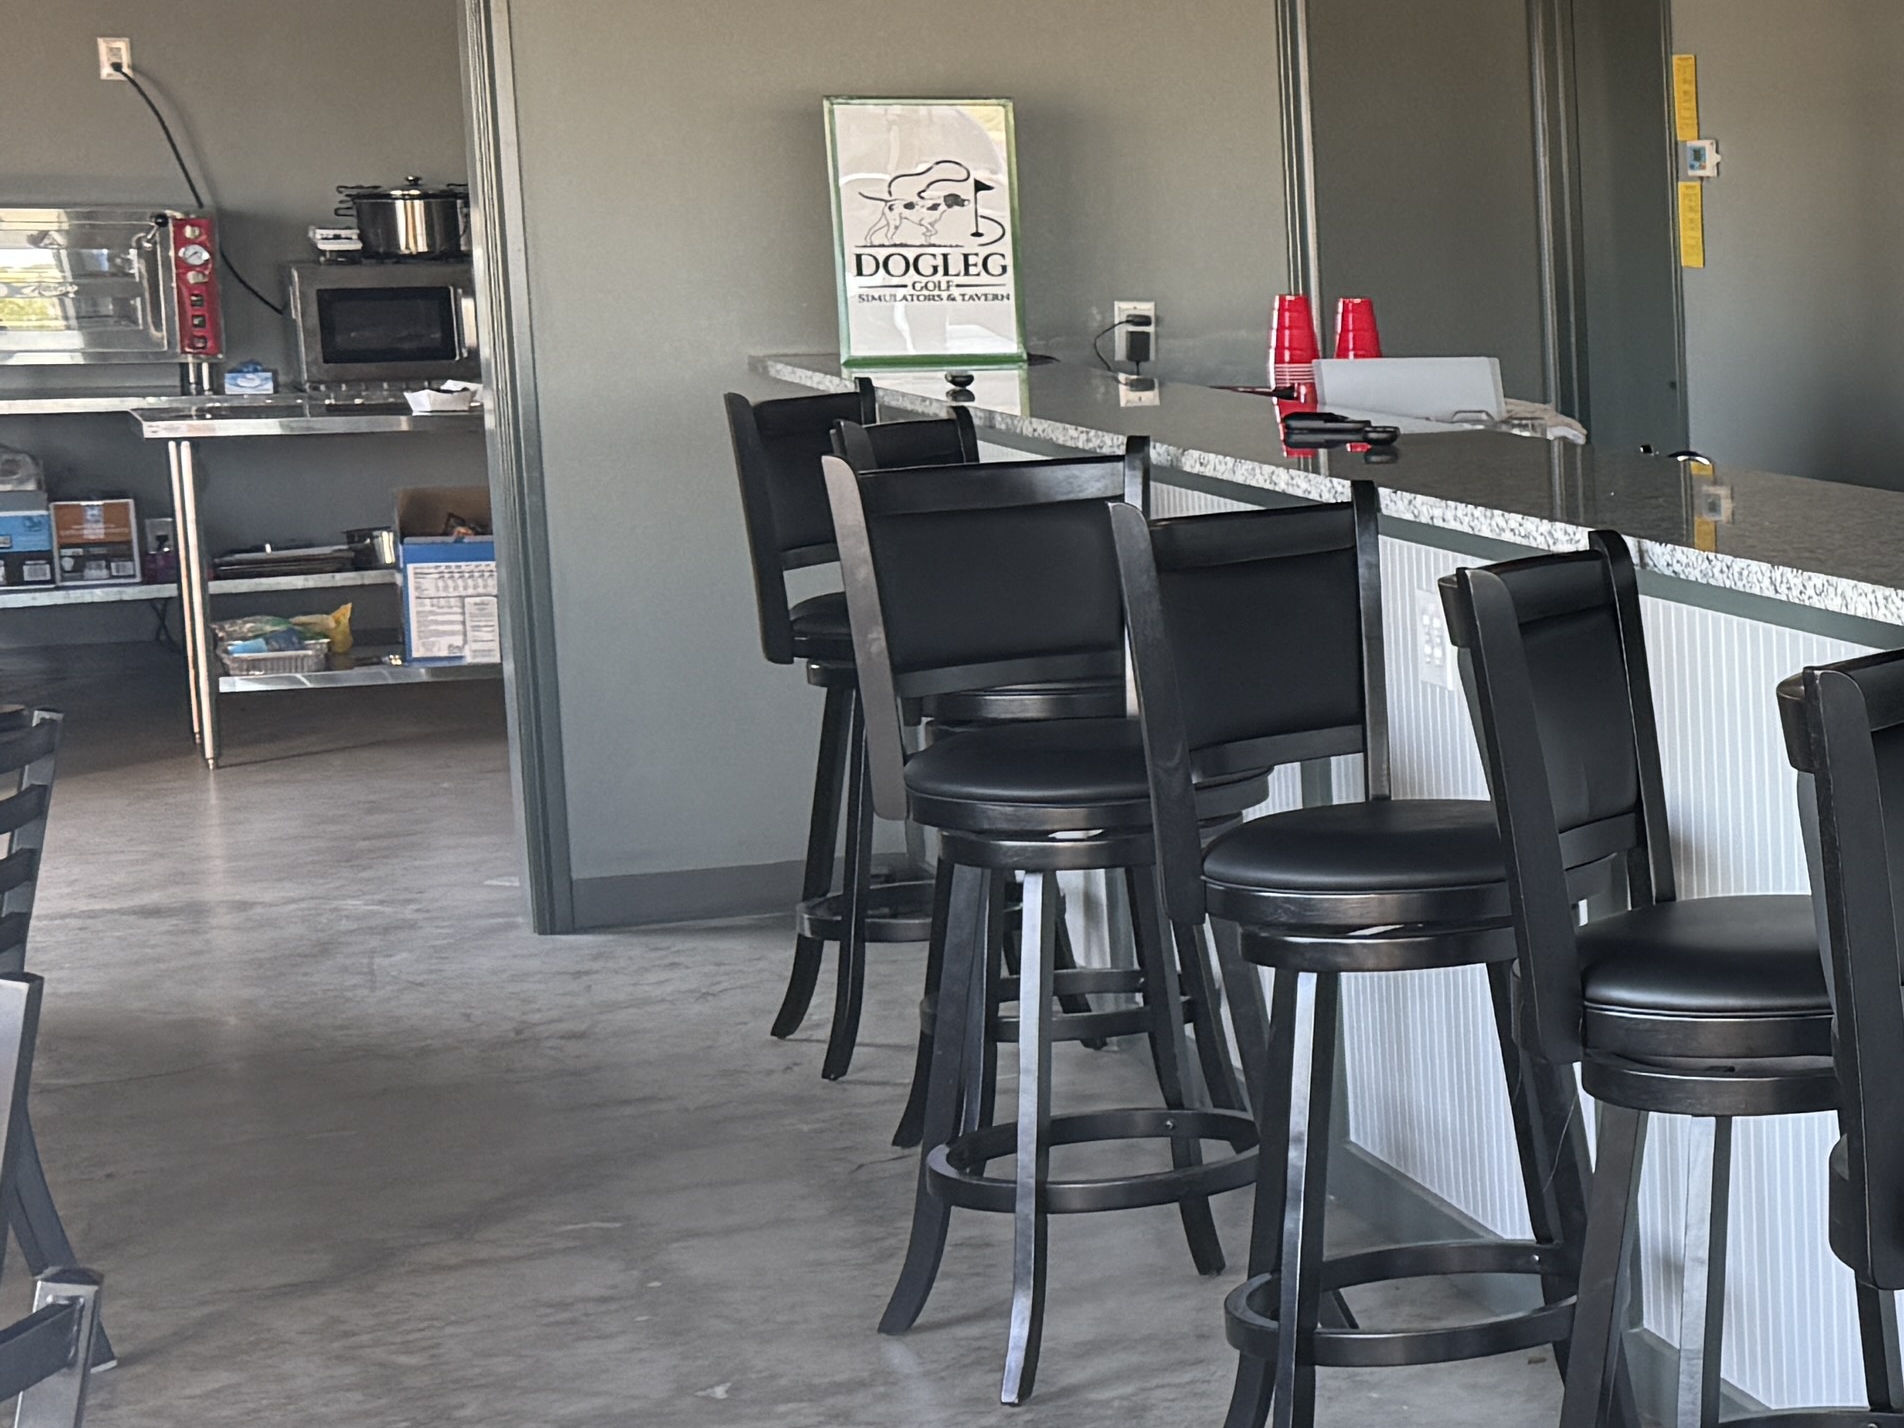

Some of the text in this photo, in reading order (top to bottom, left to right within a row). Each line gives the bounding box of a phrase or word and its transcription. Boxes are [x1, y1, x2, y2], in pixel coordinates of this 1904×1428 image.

[854, 253, 1008, 277] DOGLEG
[911, 281, 955, 292] GOLF
[858, 292, 1011, 302] SIMULATORS & TAVERN
